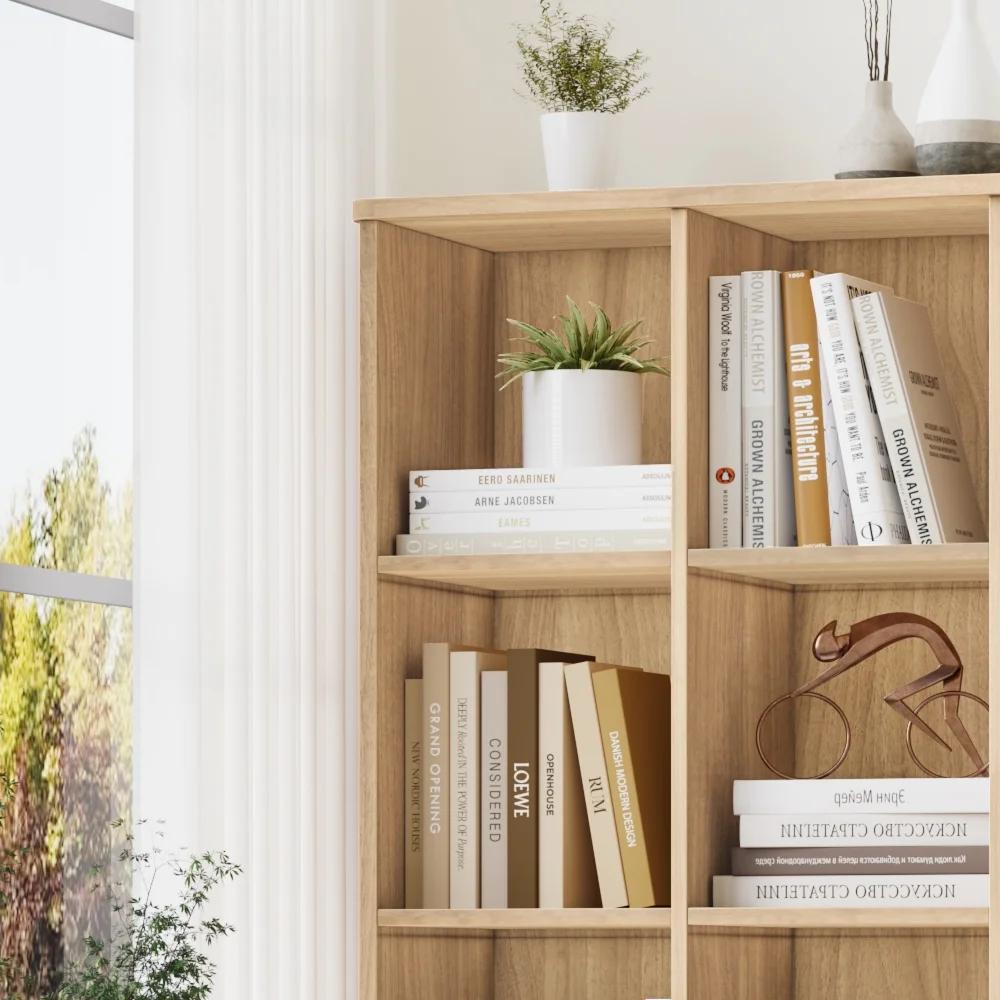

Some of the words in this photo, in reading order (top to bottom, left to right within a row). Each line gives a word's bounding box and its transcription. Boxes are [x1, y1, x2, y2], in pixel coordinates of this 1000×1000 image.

[718, 283, 732, 312] Virginia
[720, 313, 732, 335] Woolf
[721, 347, 730, 358] the
[751, 318, 765, 394] ALCHEMIST
[870, 334, 898, 406] ALCHEMIST
[719, 358, 730, 392] Lighthouse
[832, 340, 845, 352] YOU
[845, 412, 859, 424] YOU
[751, 420, 764, 473] GROWN
[793, 394, 818, 482] architecture
[892, 428, 914, 478] GROWN
[478, 474, 503, 486] EERO
[507, 472, 556, 485] SAARINEN
[474, 496, 500, 507] ARNE
[504, 496, 555, 507] JACOBSEN
[498, 517, 531, 528] EAMES
[430, 702, 440, 756] GRAND
[457, 698, 467, 729] DEEPLY
[412, 741, 420, 763] NEW
[608, 731, 622, 766] DANISH
[411, 768, 421, 808] NORDIC
[430, 763, 440, 834] OPENING
[457, 772, 467, 788] THE
[489, 738, 501, 843] CONSIDERED
[513, 762, 530, 819] LOEWE
[546, 753, 554, 816] OPENHOUSE
[614, 767, 631, 812] MODERN
[457, 791, 467, 822] POWER
[411, 813, 421, 852] HOUSES
[457, 824, 467, 837] OF
[622, 812, 638, 848] DESIGN
